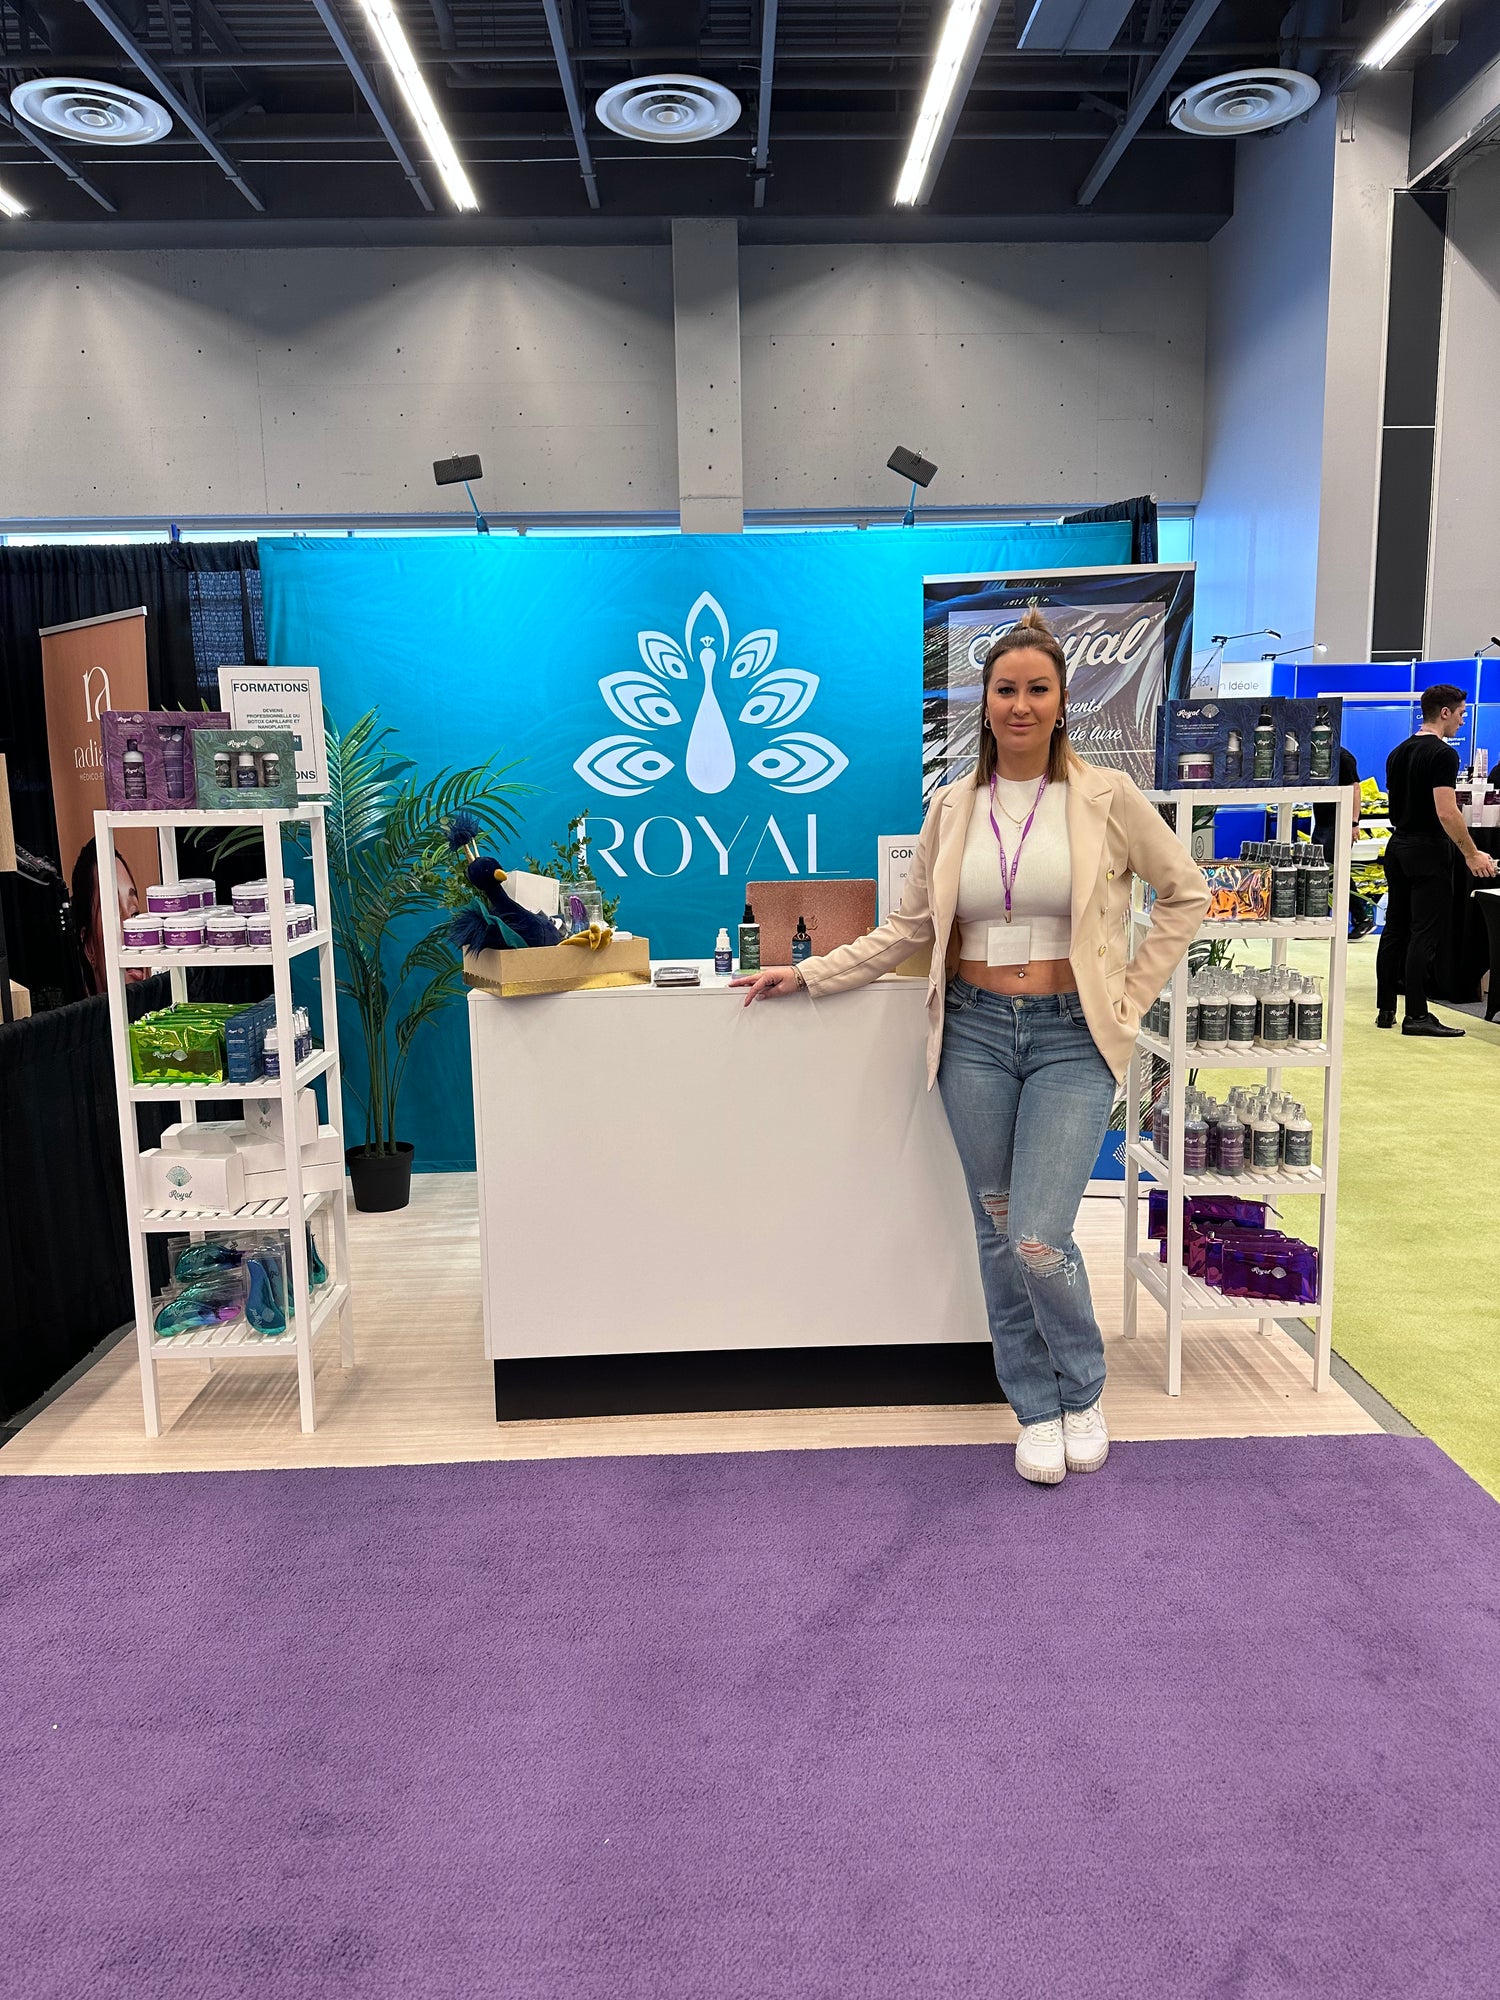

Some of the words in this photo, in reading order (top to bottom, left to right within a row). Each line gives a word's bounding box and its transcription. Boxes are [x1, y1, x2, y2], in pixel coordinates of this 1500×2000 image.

[233, 683, 309, 693] FORMATIONS
[1176, 709, 1201, 719] Royal
[1068, 726, 1087, 741] de
[1088, 725, 1123, 741] luxe
[227, 739, 248, 749] Royal
[576, 813, 850, 878] ROYAL
[168, 1189, 193, 1202] Royal
